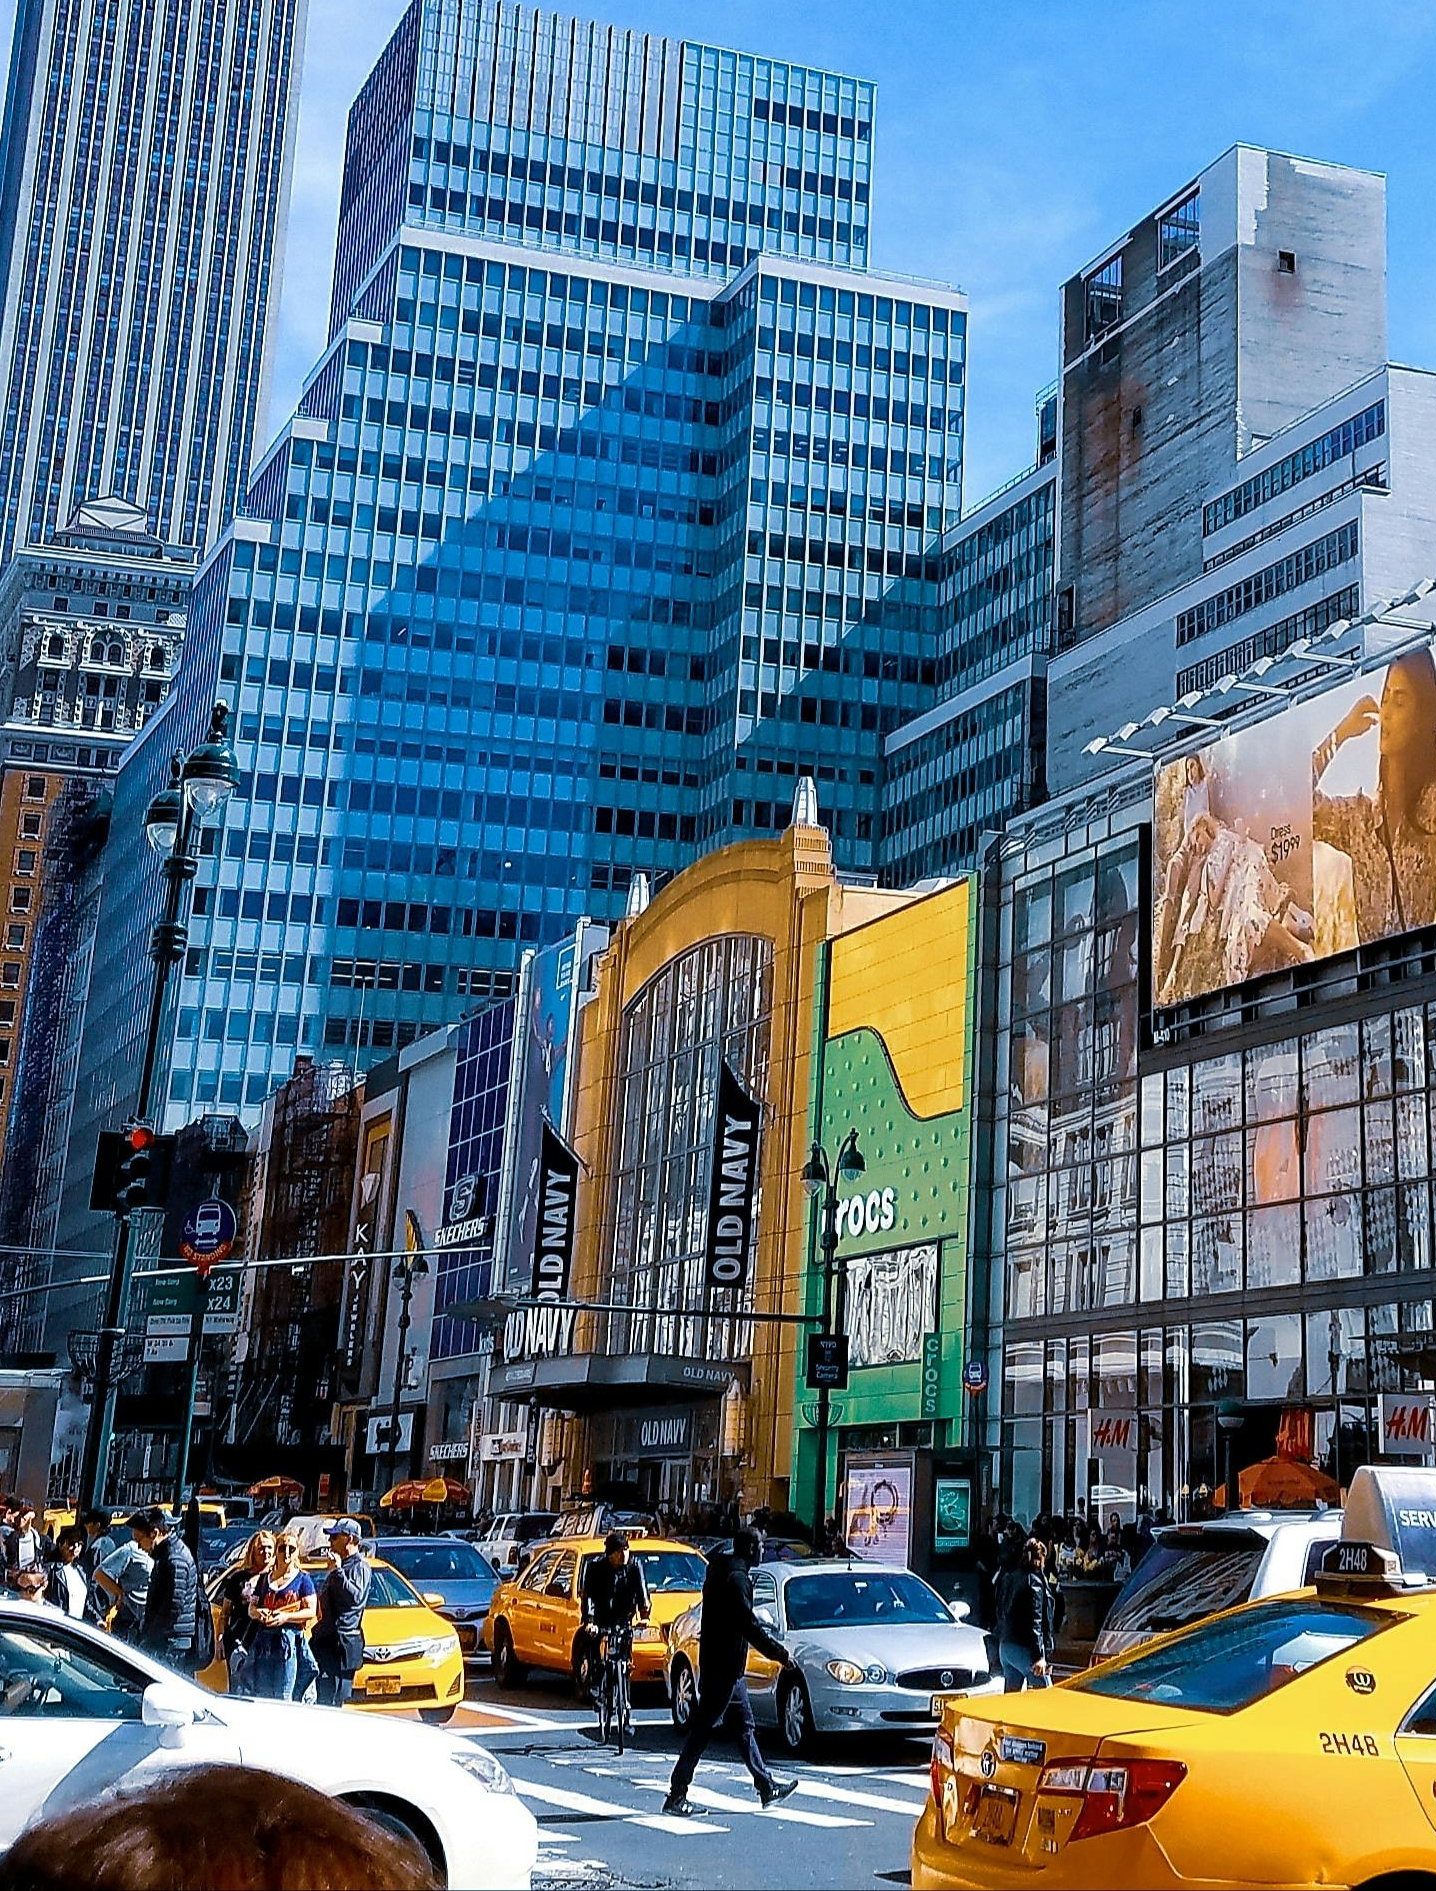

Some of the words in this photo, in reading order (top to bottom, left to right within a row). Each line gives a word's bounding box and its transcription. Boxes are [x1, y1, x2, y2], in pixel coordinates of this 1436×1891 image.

[1270, 824, 1292, 841] Dress
[719, 1114, 752, 1207] NAVY
[542, 1169, 571, 1247] NAVY
[822, 1186, 895, 1240] rocs
[434, 1217, 486, 1246] SKECHERS
[351, 1223, 369, 1289] KAY
[712, 1215, 743, 1281] OLD
[504, 1310, 525, 1360] OLD
[525, 1306, 574, 1357] NAVY
[683, 1366, 704, 1379] OLD
[706, 1369, 735, 1382] NAVY
[641, 1420, 659, 1446] OLD
[660, 1418, 687, 1445] NAVY
[1094, 1418, 1131, 1449] H&M
[1386, 1406, 1429, 1442] H&M
[429, 1442, 468, 1460] SKECHERS
[1339, 1548, 1367, 1571] 2H48
[1319, 1732, 1379, 1756] 2H48
